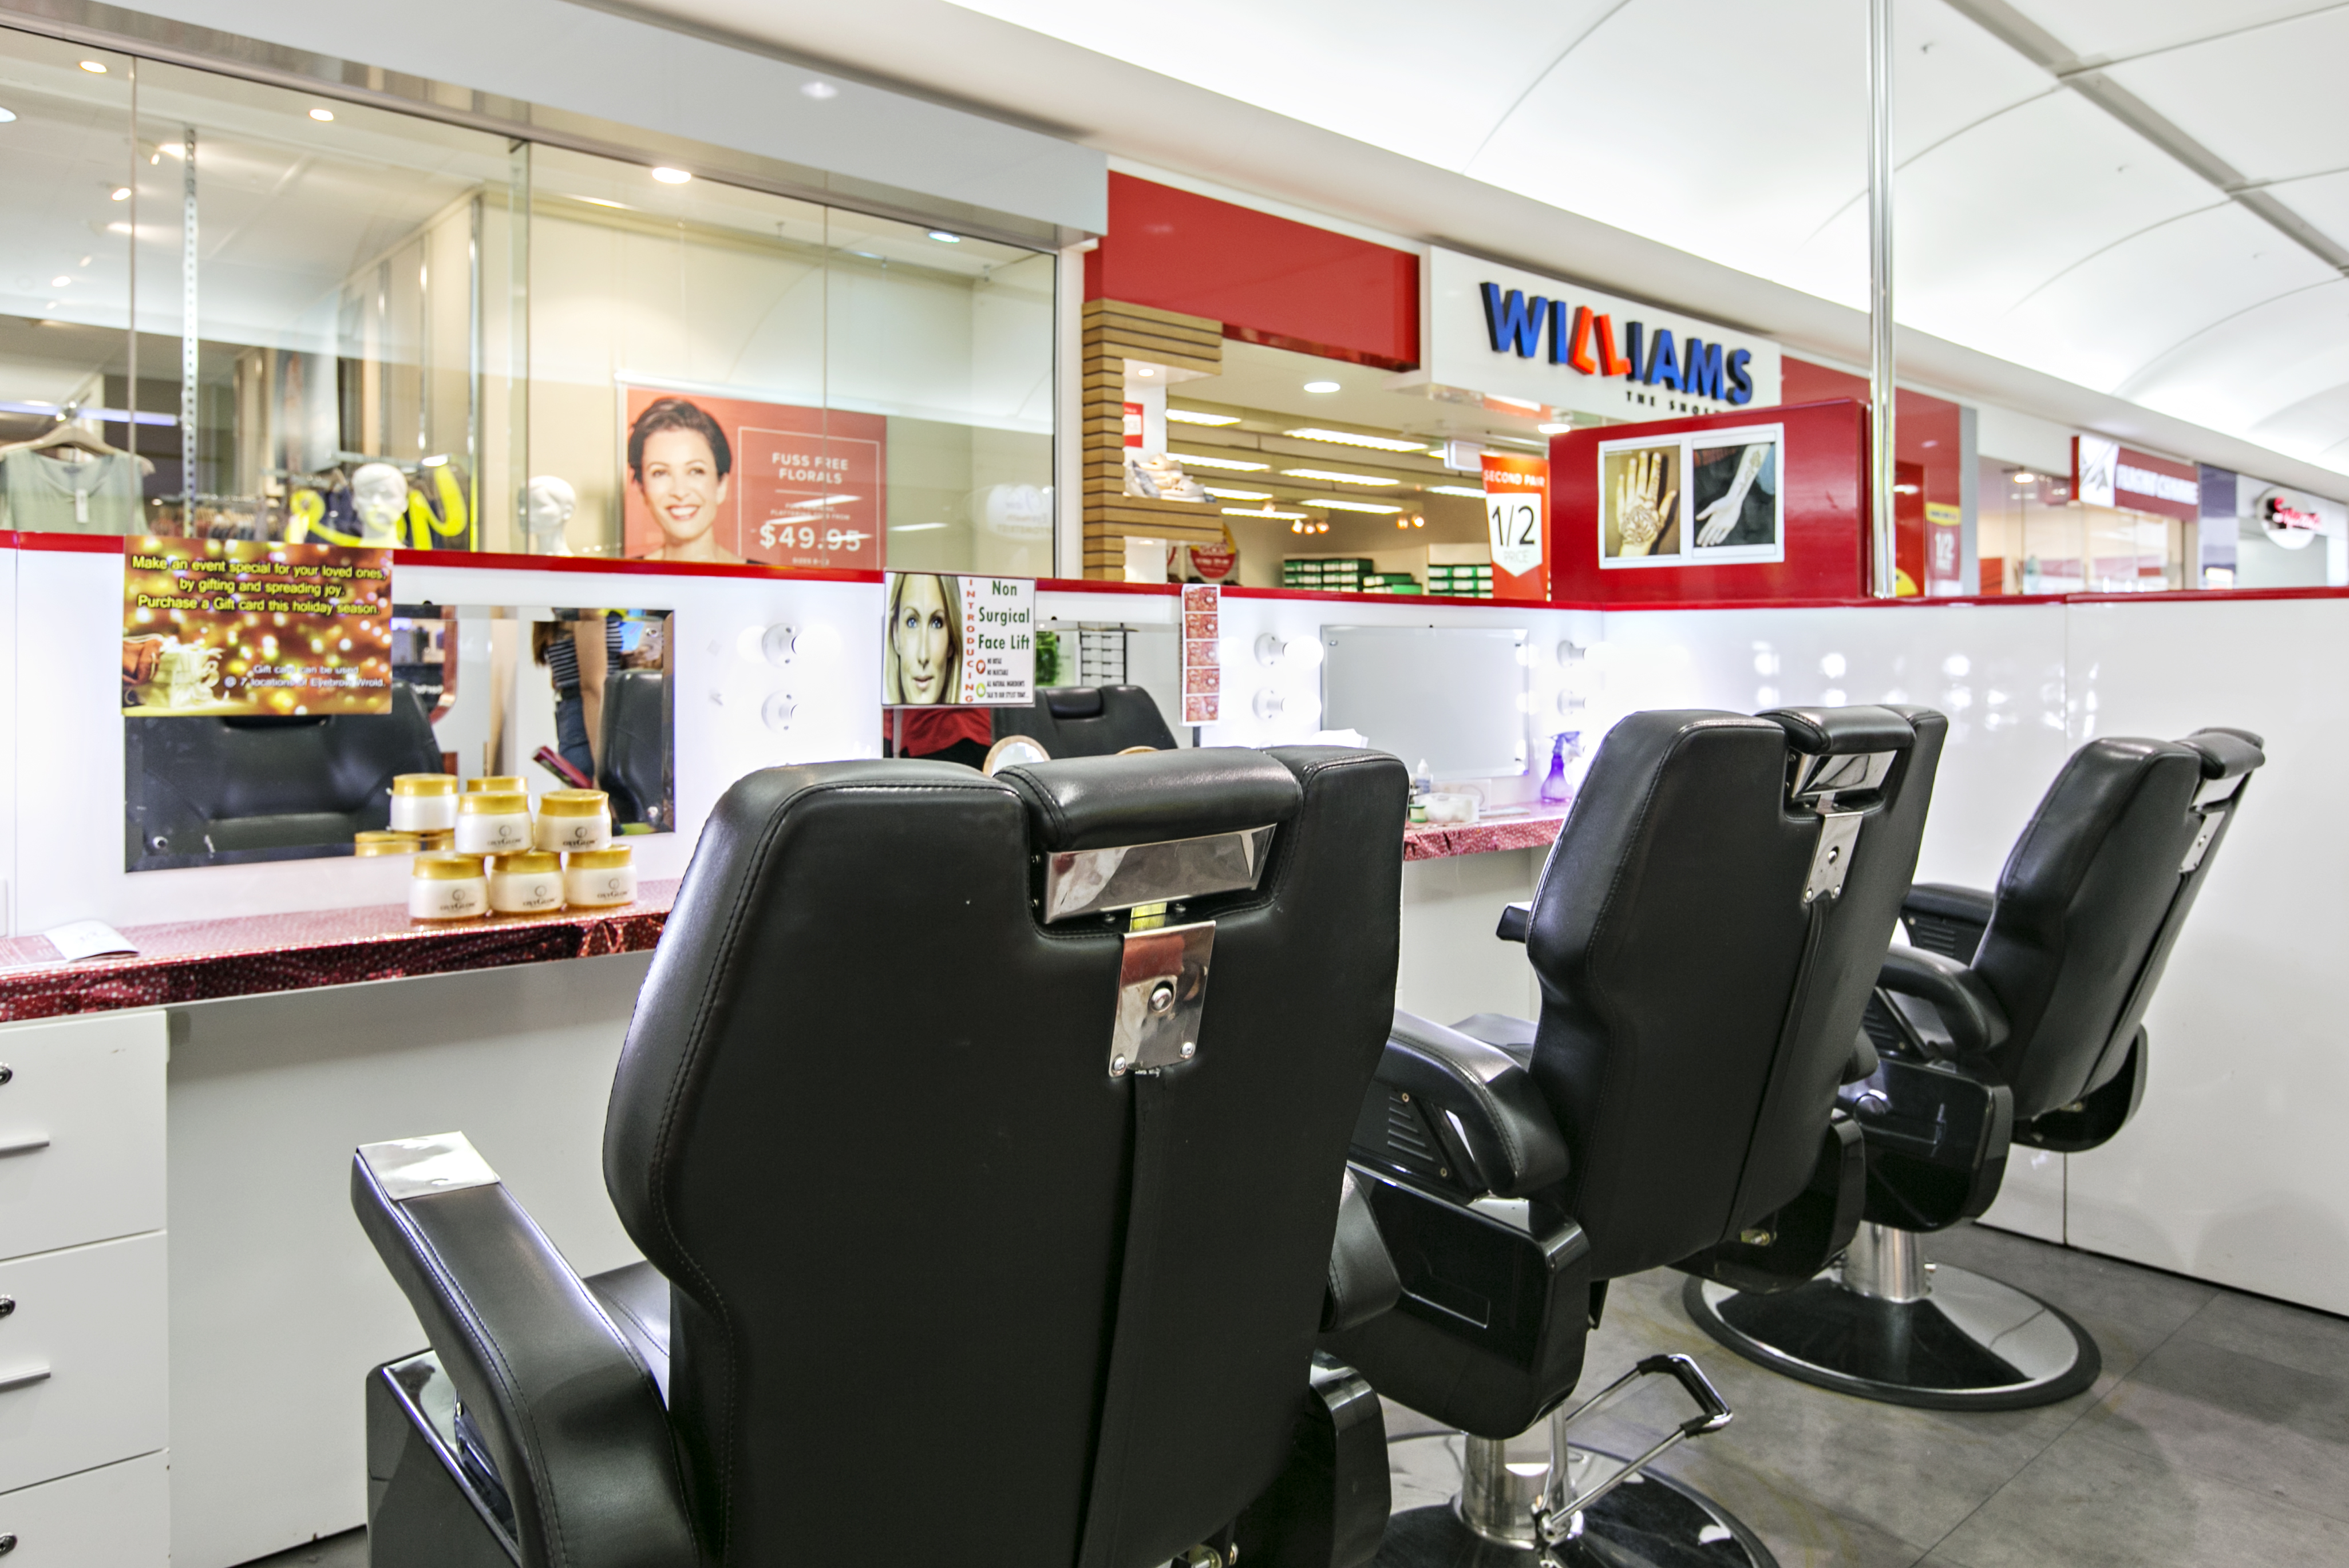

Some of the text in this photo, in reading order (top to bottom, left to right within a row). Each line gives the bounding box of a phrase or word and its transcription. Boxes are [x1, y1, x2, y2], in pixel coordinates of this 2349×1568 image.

[1480, 281, 1753, 406] WILLIAMS
[1627, 391, 1721, 415] THE SHOE
[772, 452, 849, 471] FUSS FREE
[779, 467, 843, 484] FLORALS
[1483, 470, 1545, 487] SECOND PAIR
[1492, 505, 1535, 547] 1/2
[760, 524, 861, 552] $49.95
[132, 555, 386, 580] Make an event special for your loved ones,
[179, 577, 345, 597] by gifting and spreading joy.
[992, 580, 1018, 596] Non
[138, 595, 380, 616] Purchase a Gift card this holiday season.
[979, 606, 1030, 627] Surgical
[965, 579, 975, 703] INTRODUCING
[978, 633, 1030, 650] Face Lift
[252, 664, 271, 674] Gift
[299, 666, 317, 674] can
[319, 666, 333, 674] be
[224, 675, 236, 688] @
[239, 678, 247, 686] 7
